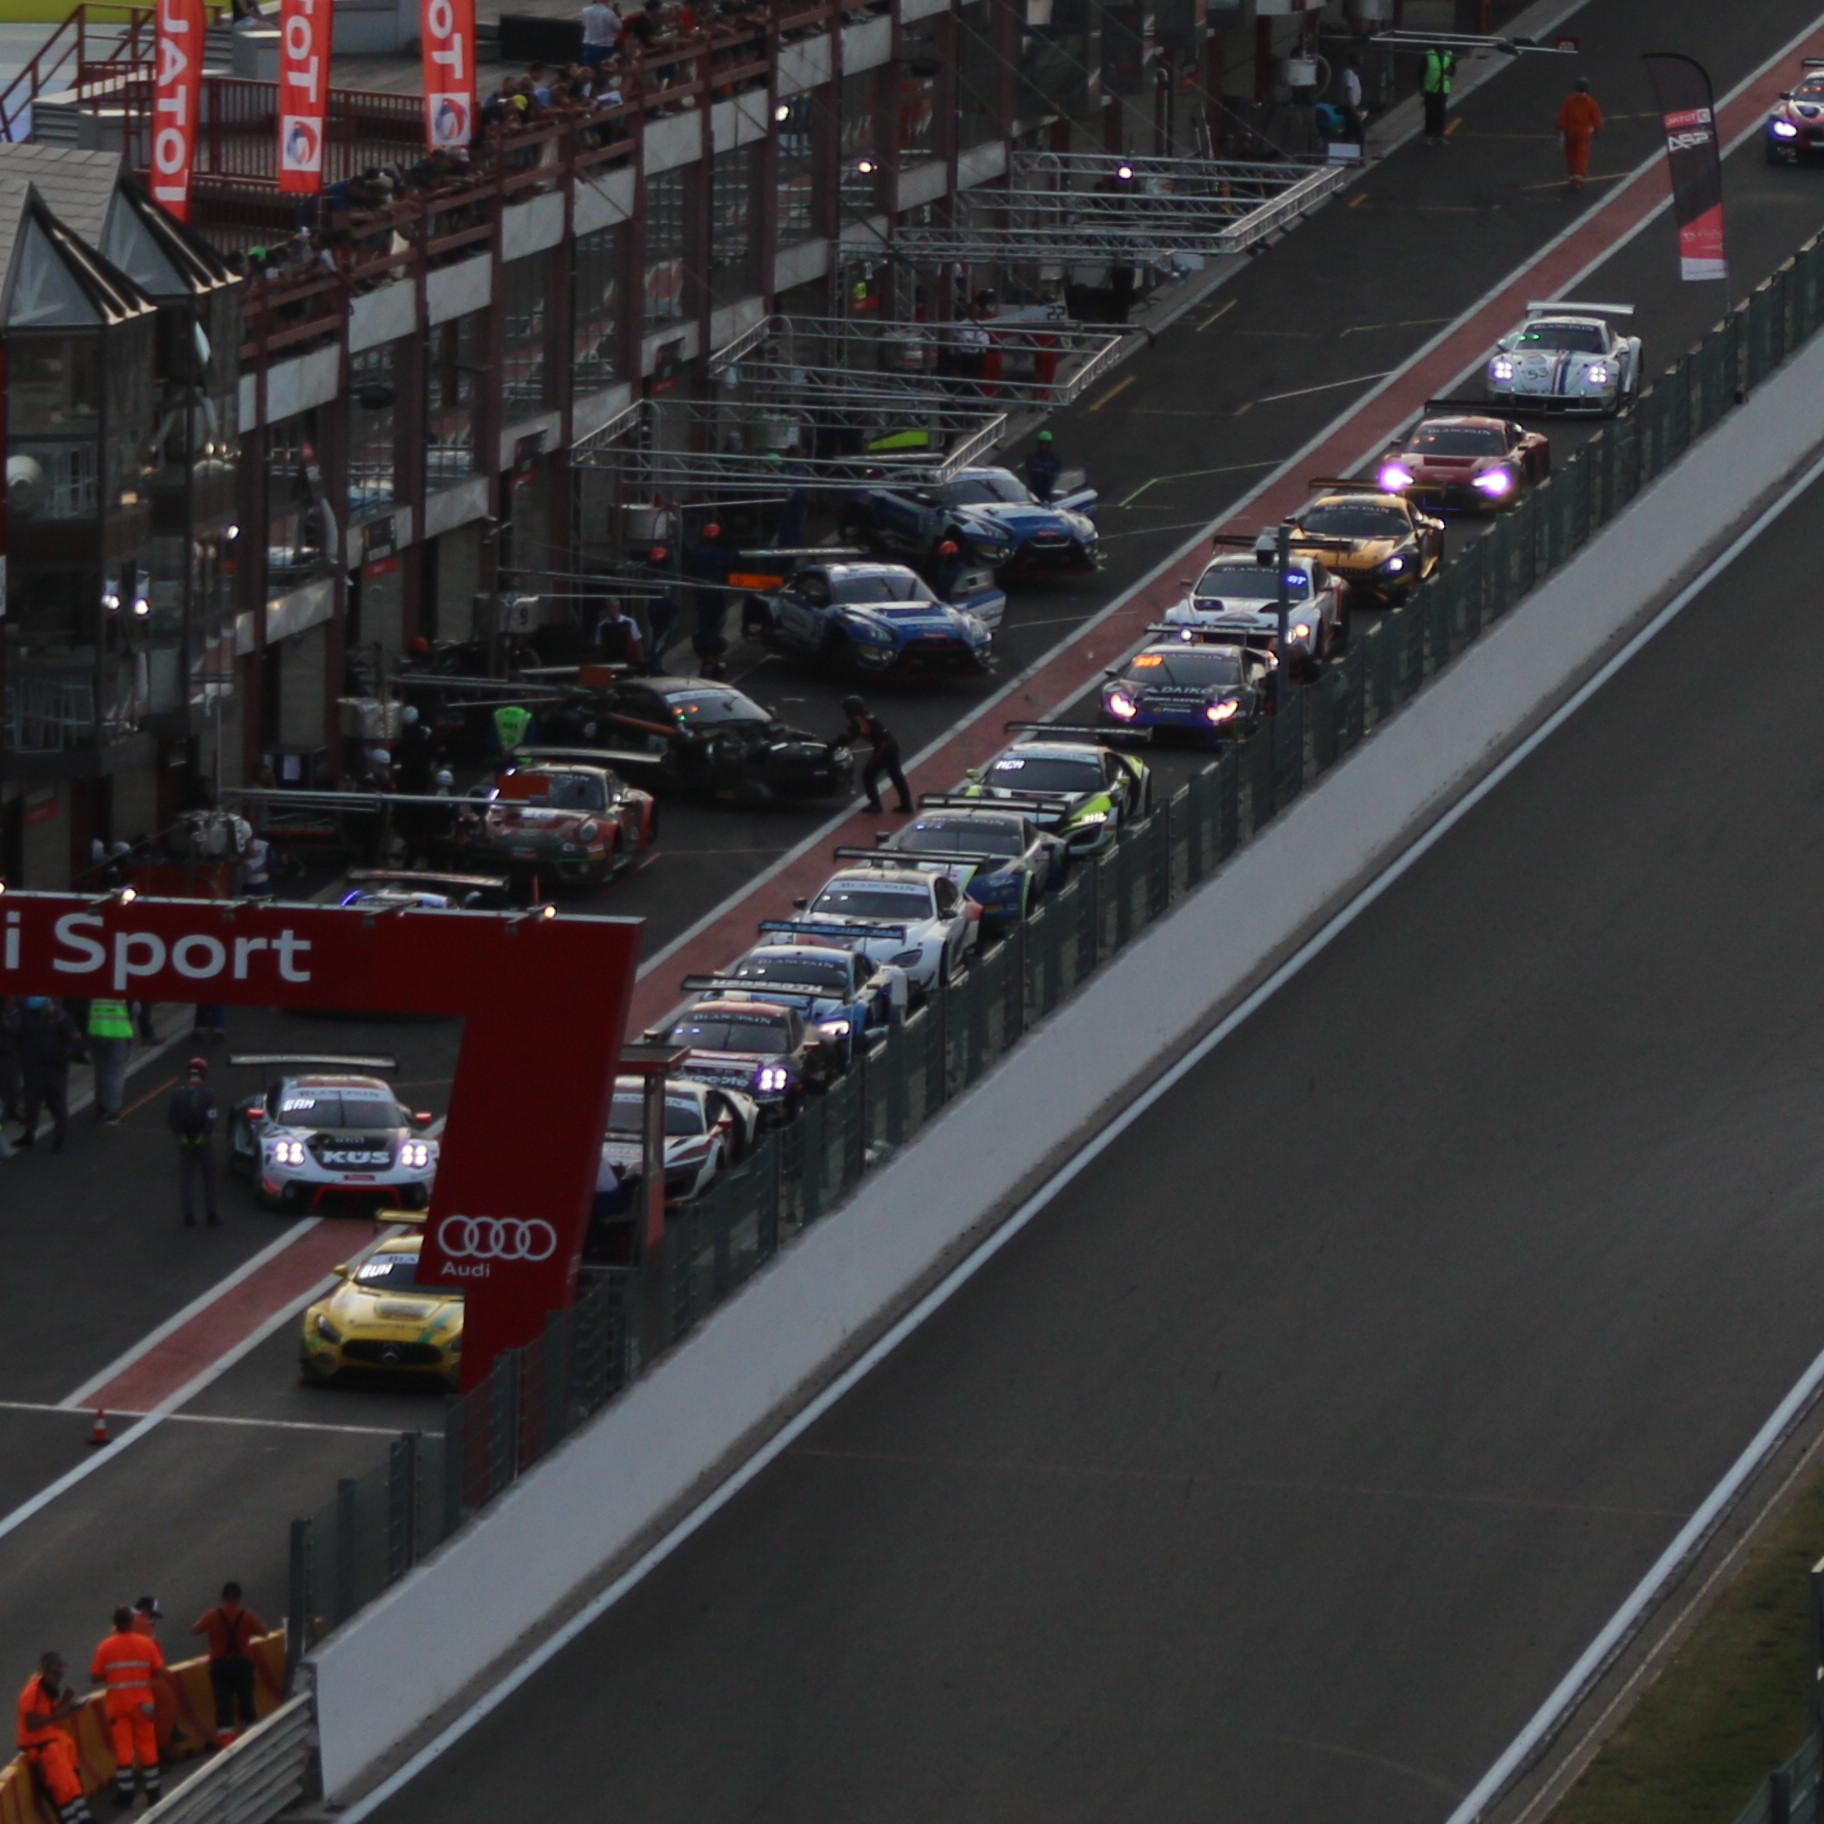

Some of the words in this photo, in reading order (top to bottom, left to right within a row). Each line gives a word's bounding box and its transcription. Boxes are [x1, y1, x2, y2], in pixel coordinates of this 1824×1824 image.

[1526, 366, 1550, 381] 53
[51, 909, 314, 1002] Sport
[692, 1013, 772, 1026] BLANCPAIN
[322, 1148, 391, 1165] KÜS
[441, 1261, 491, 1278] Audi
